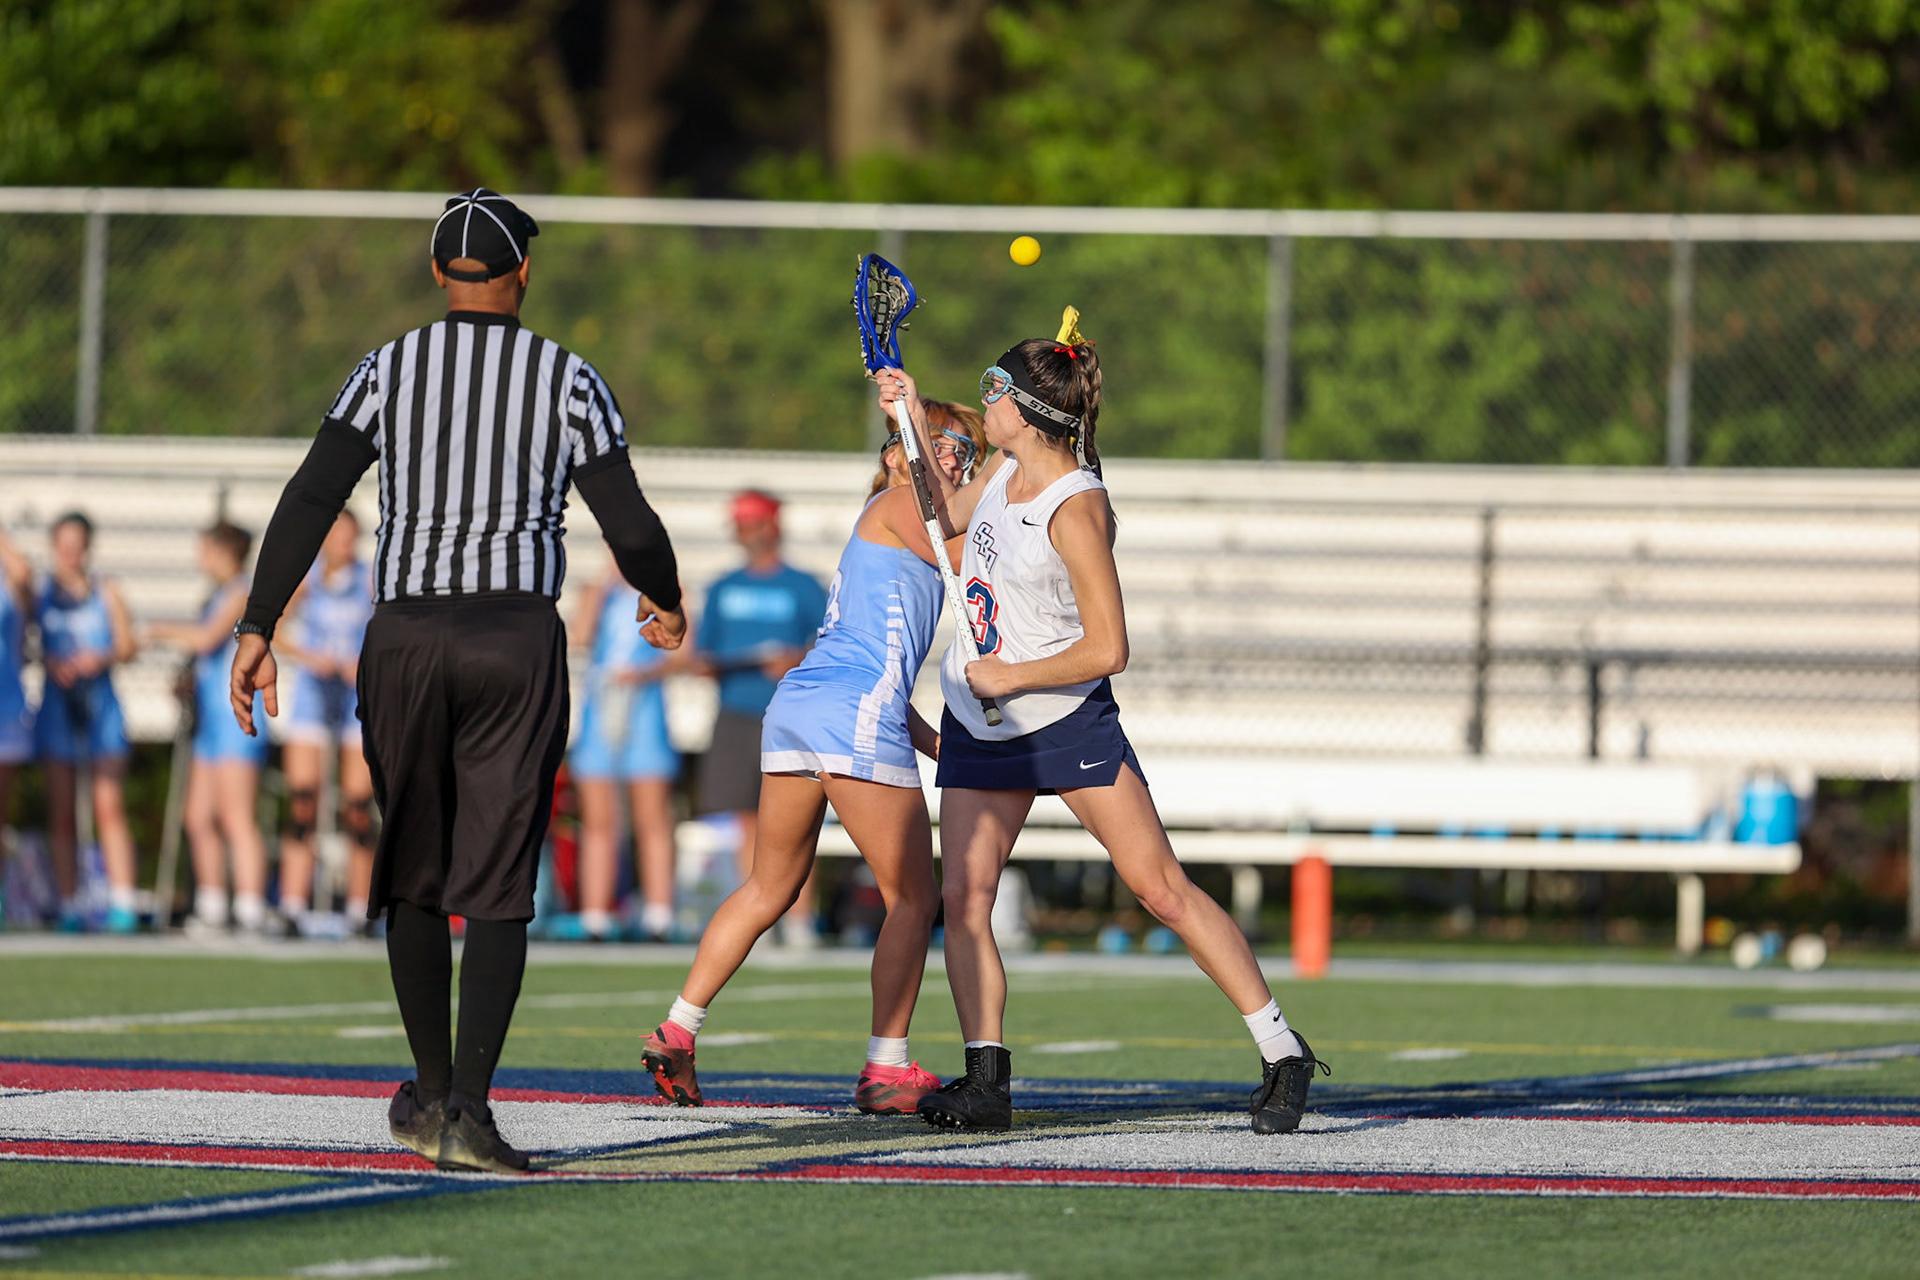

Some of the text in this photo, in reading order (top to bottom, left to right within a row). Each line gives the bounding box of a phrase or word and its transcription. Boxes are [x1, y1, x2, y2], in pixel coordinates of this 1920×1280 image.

[1007, 386, 1021, 399] TX
[1028, 400, 1055, 418] STX
[966, 576, 1003, 656] 3
